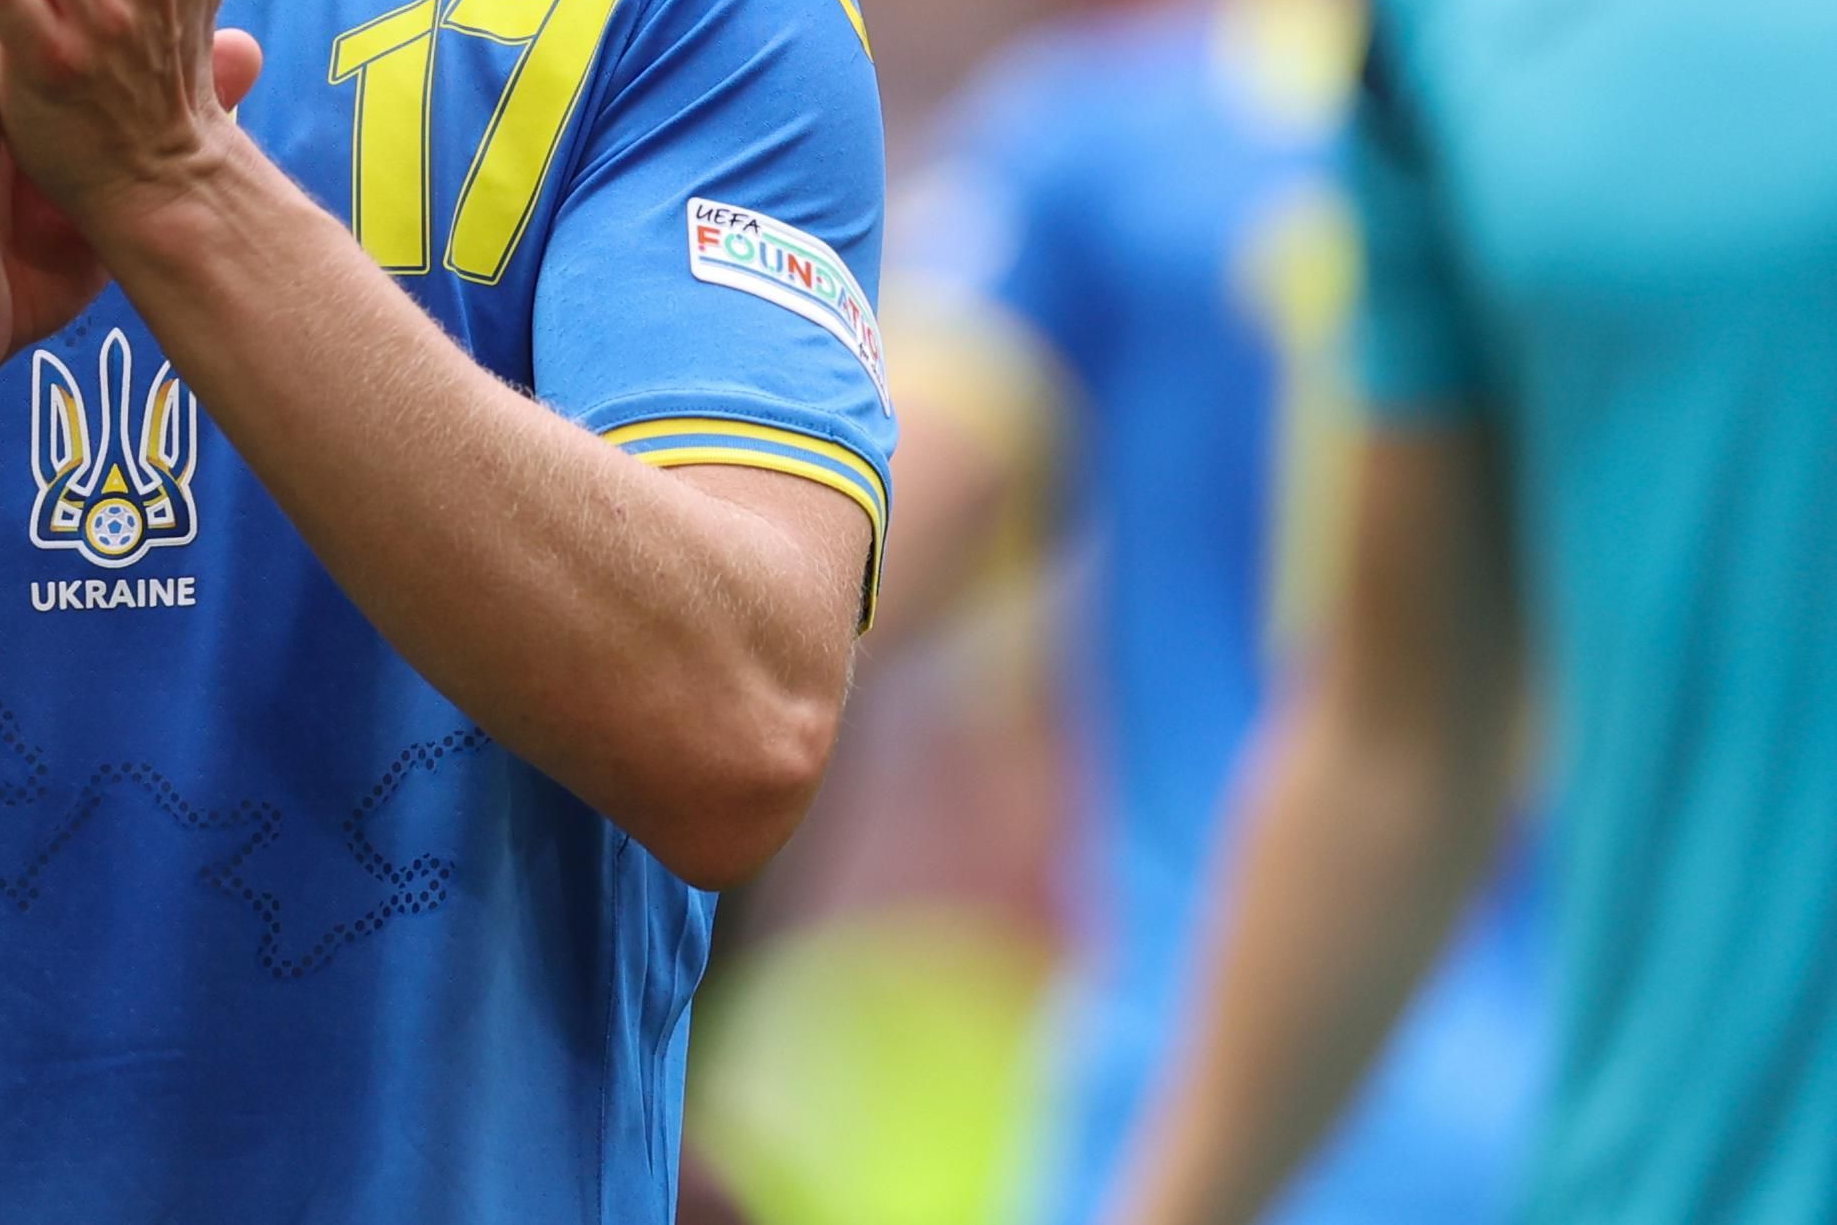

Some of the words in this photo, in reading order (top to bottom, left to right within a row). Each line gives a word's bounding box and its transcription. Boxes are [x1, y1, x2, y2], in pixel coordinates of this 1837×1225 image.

[696, 204, 761, 234] UEFA
[696, 225, 879, 360] FOUNDATIO
[30, 577, 197, 612] UKRAINE
